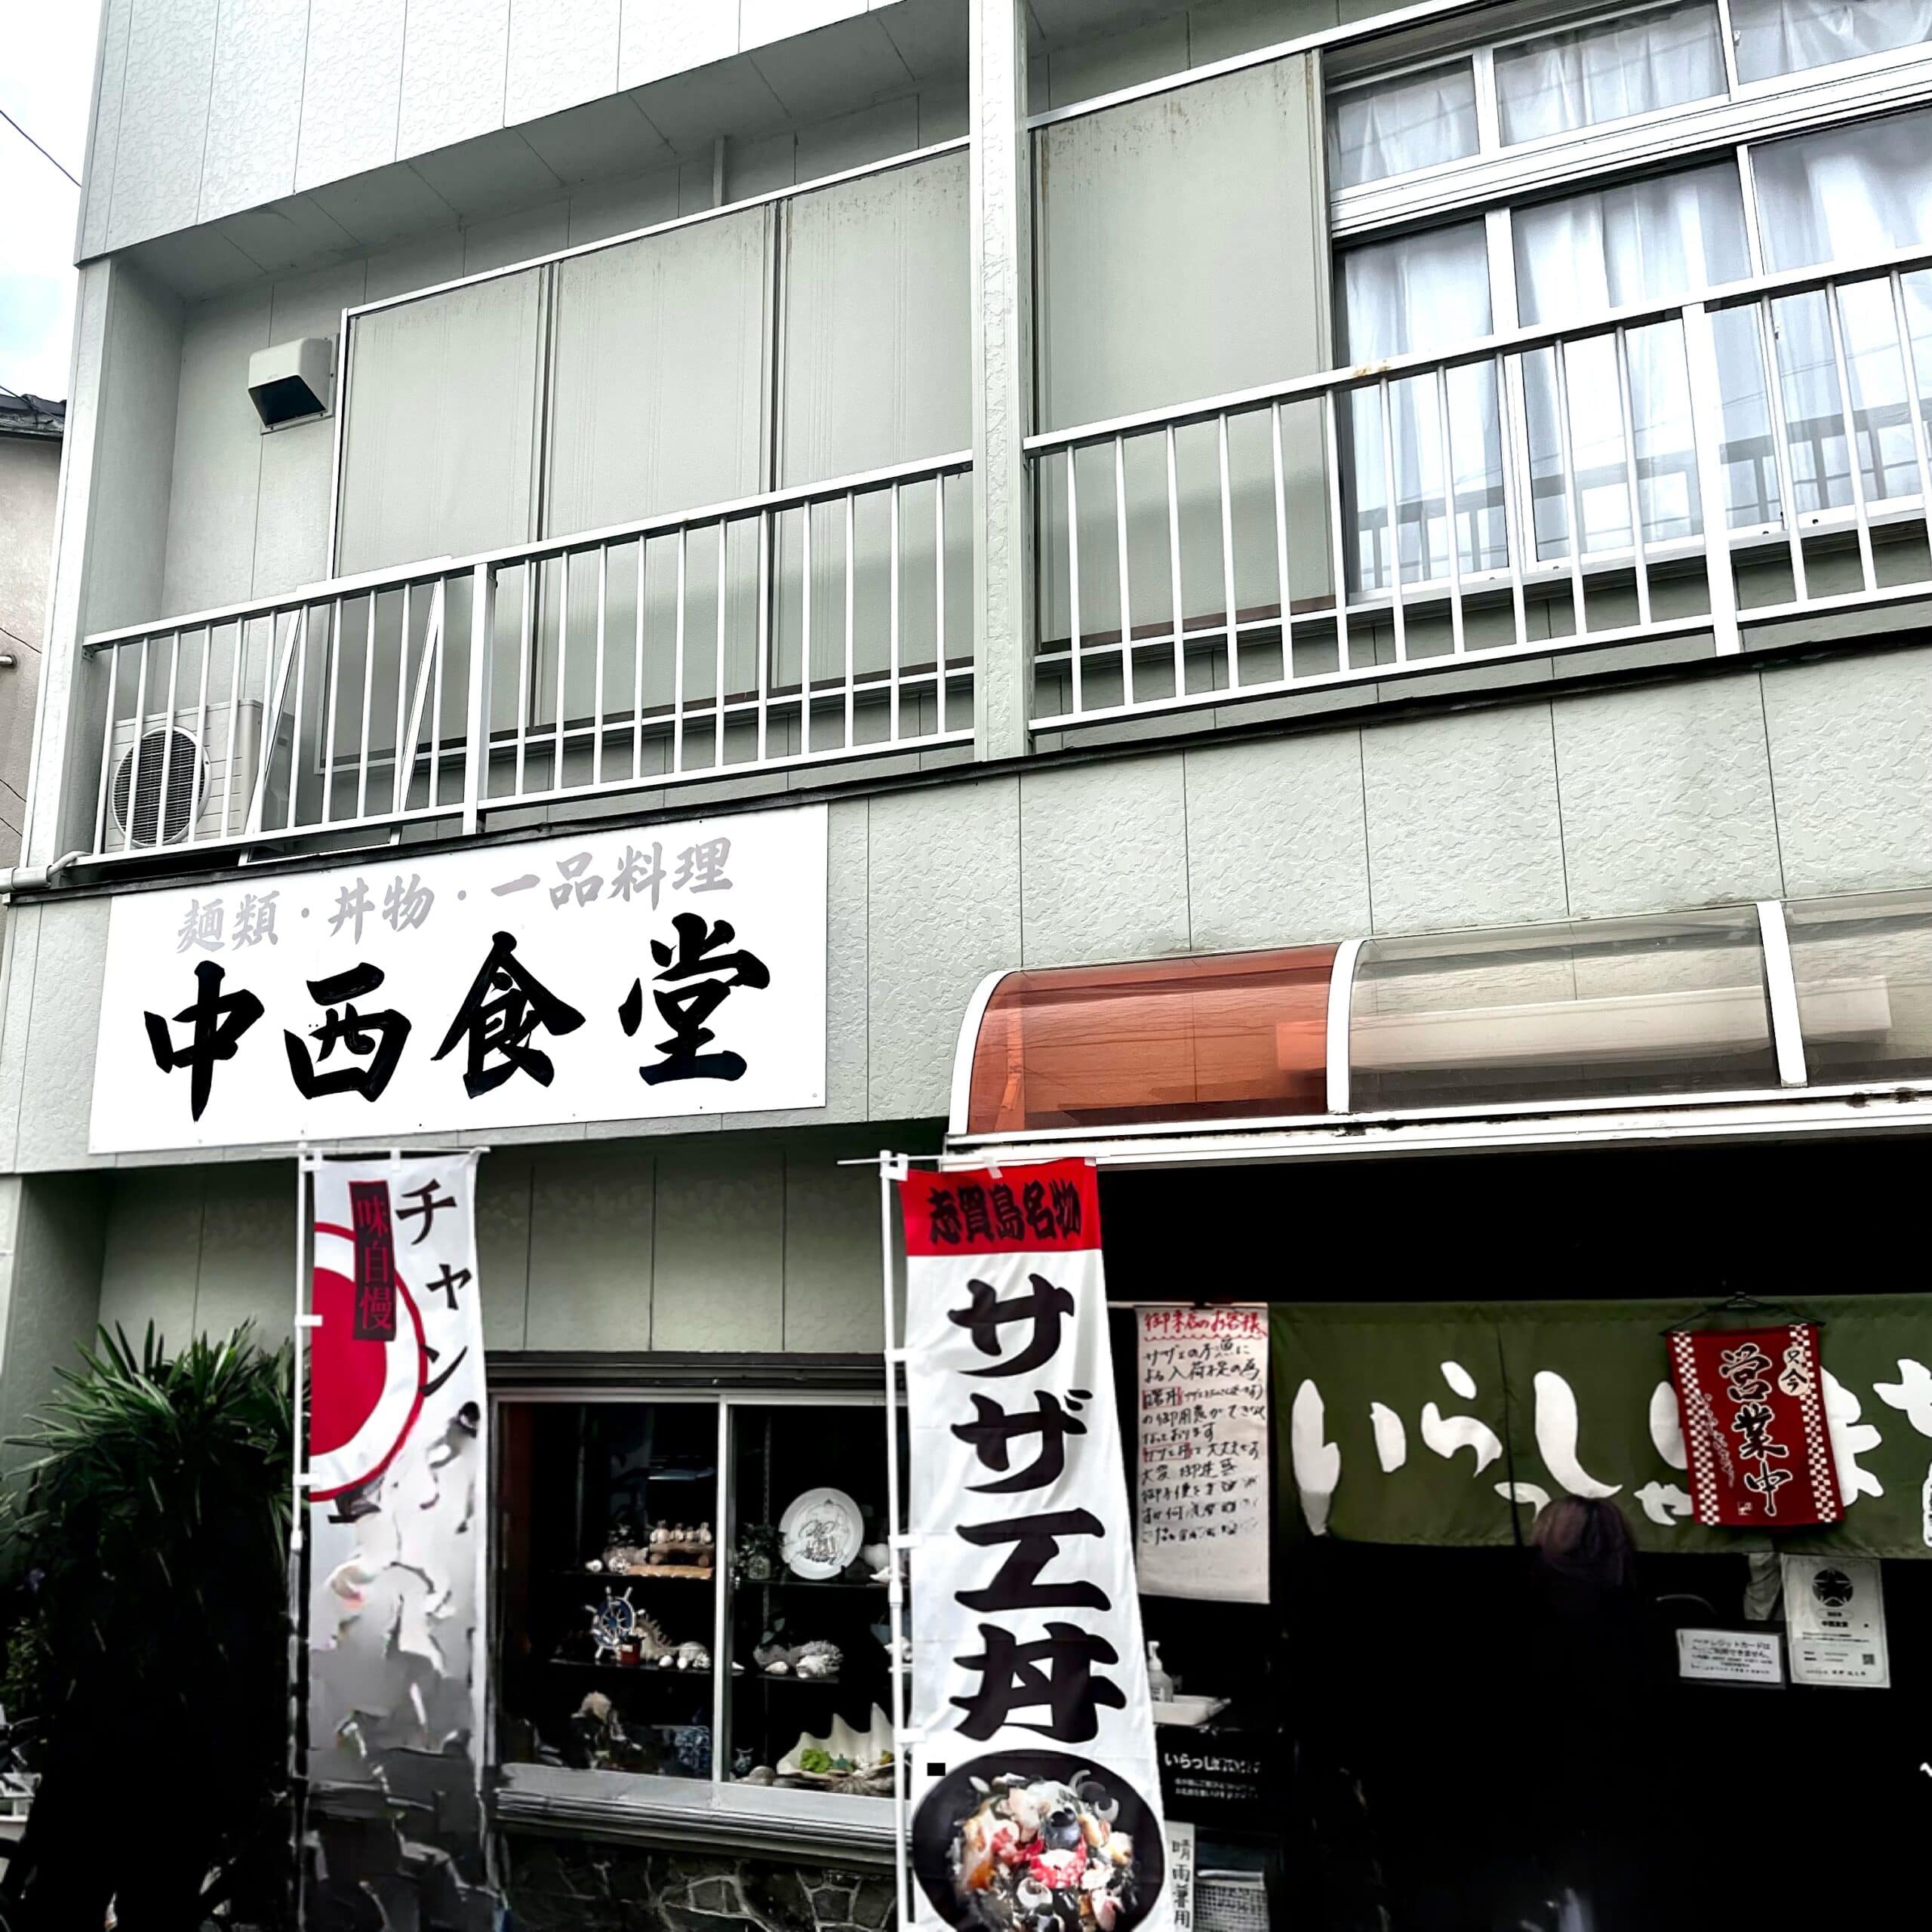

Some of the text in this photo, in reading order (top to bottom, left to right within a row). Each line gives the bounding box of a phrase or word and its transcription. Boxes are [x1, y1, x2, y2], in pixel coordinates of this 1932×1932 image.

[143, 912, 771, 1122] 中西食堂
[356, 1195, 395, 1331] 味自慢
[1718, 1343, 1793, 1518] 営業中
[1780, 1346, 1808, 1393] 只今
[947, 1272, 1127, 1743] サザエ丼
